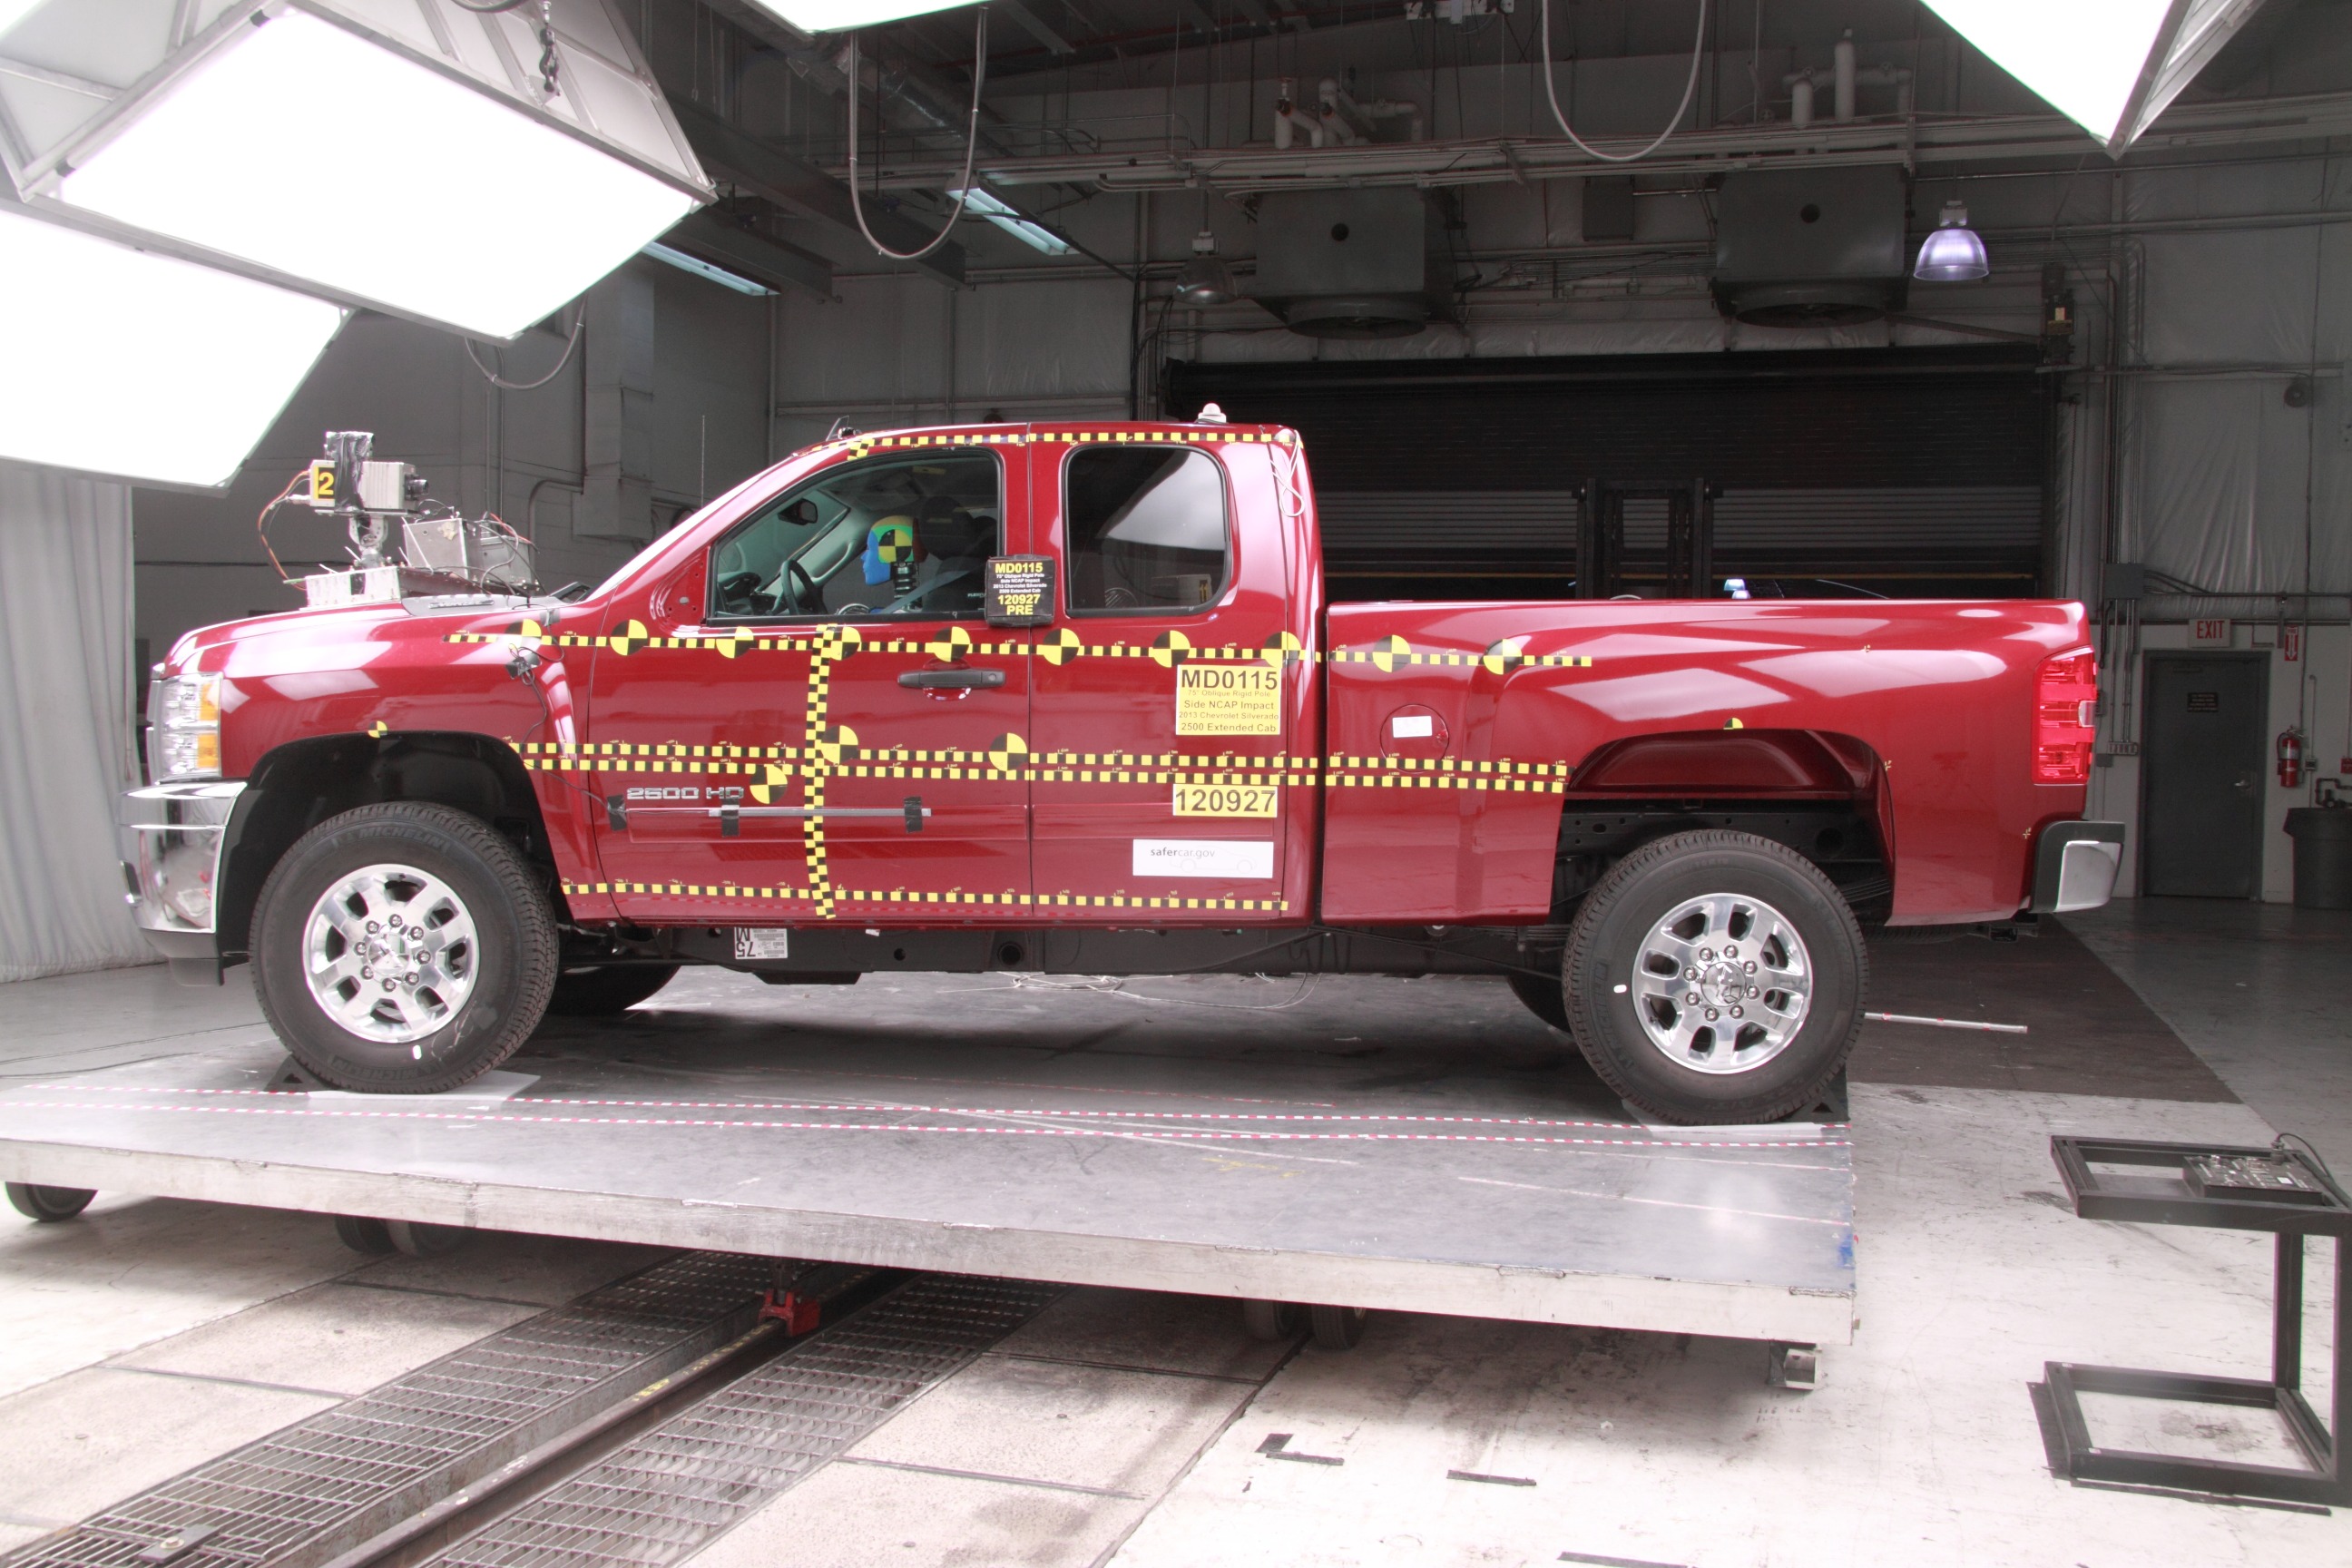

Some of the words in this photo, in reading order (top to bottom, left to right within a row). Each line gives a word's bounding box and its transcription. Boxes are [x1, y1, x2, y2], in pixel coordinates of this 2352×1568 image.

[318, 471, 334, 495] 2
[995, 563, 1044, 573] MD0115
[997, 594, 1041, 605] 120927
[1006, 605, 1034, 616] PRE
[2196, 620, 2226, 640] EXIT
[1181, 669, 1278, 691] MD0115
[1201, 690, 1230, 698] Oblique
[1232, 690, 1252, 699] Rigid
[1184, 700, 1206, 709] Side
[1209, 701, 1238, 709] NCAP
[1240, 701, 1274, 710] Impact
[1200, 711, 1239, 720] Chevrolet
[1181, 722, 1204, 731] 2500
[1207, 723, 1254, 731] Extended
[1257, 723, 1277, 732] Cab
[626, 787, 700, 799] 2500
[705, 787, 744, 799] HD
[1175, 789, 1277, 812] 120927
[358, 826, 445, 848] MICHELIN
[1150, 846, 1216, 859] safercar.gov
[736, 941, 756, 957] 75
